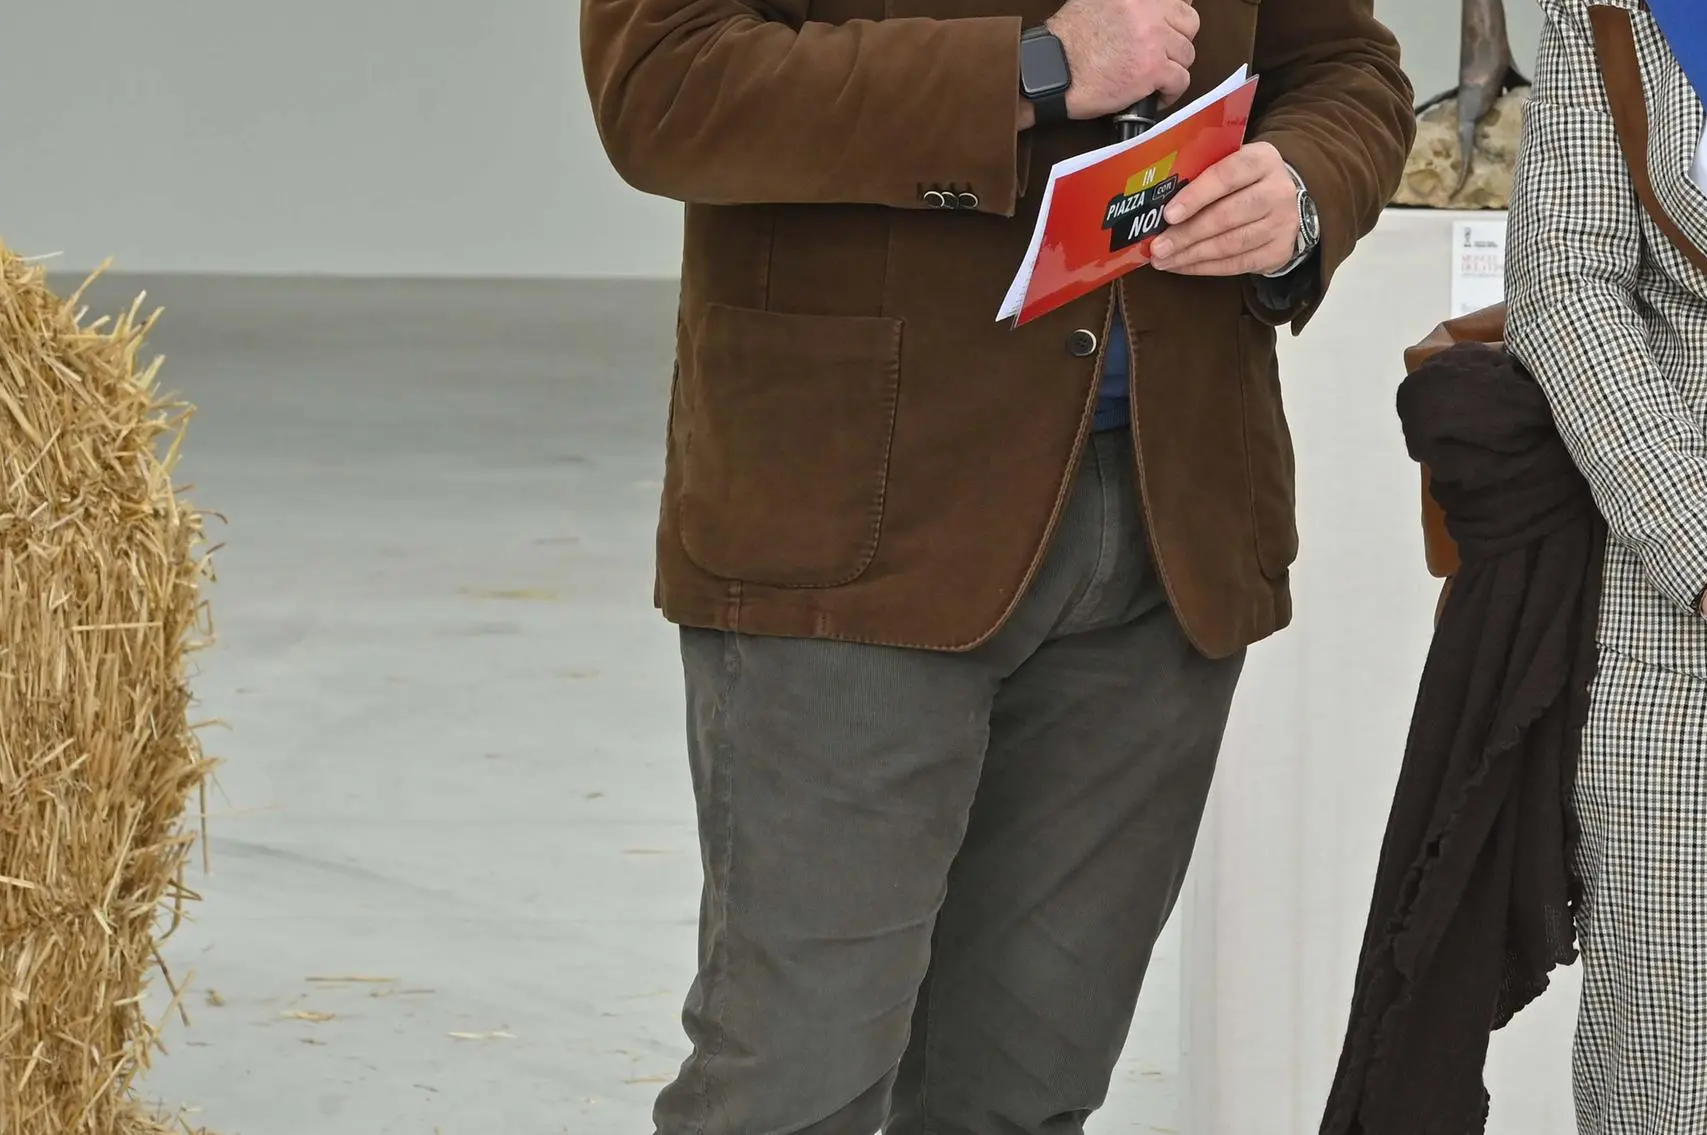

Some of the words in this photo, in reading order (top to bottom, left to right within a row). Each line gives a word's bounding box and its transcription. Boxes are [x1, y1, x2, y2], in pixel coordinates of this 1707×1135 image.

[1142, 166, 1157, 187] IN
[1106, 191, 1146, 221] PIAZZA
[1156, 181, 1172, 195] con
[1127, 204, 1165, 240] NOI
